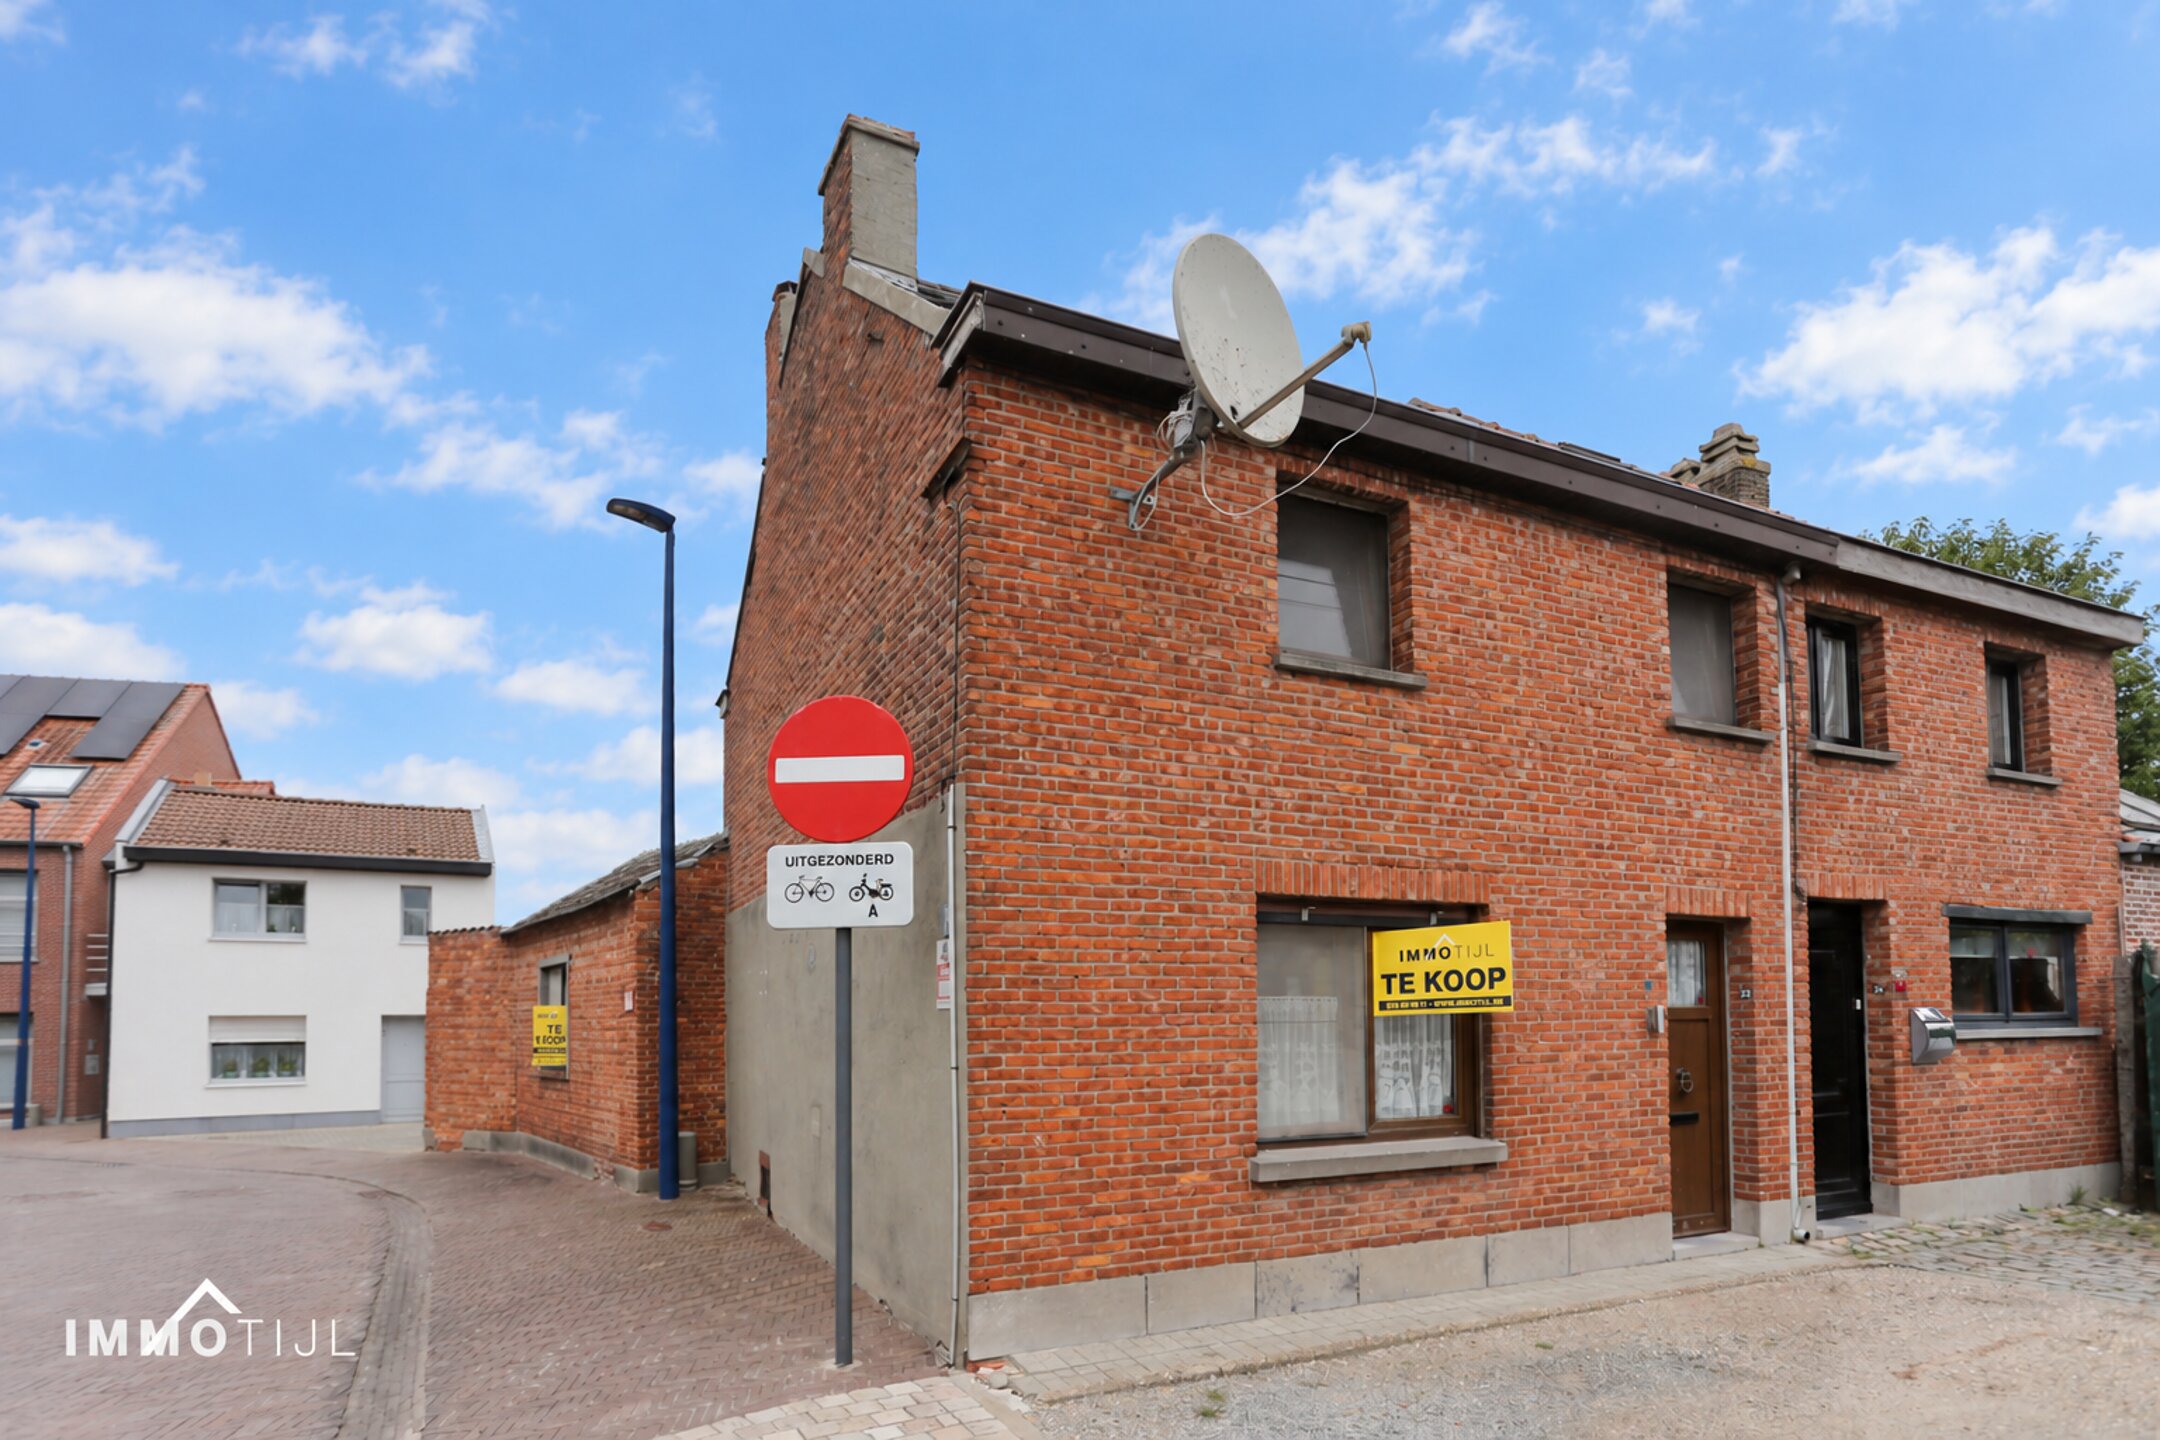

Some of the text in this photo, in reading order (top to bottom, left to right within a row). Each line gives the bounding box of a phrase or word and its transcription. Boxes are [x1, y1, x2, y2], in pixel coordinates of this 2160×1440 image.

[785, 853, 894, 867] UITGEZONDERD
[868, 903, 878, 918] A
[1381, 967, 1506, 995] TE KOOP
[547, 1024, 562, 1035] TE
